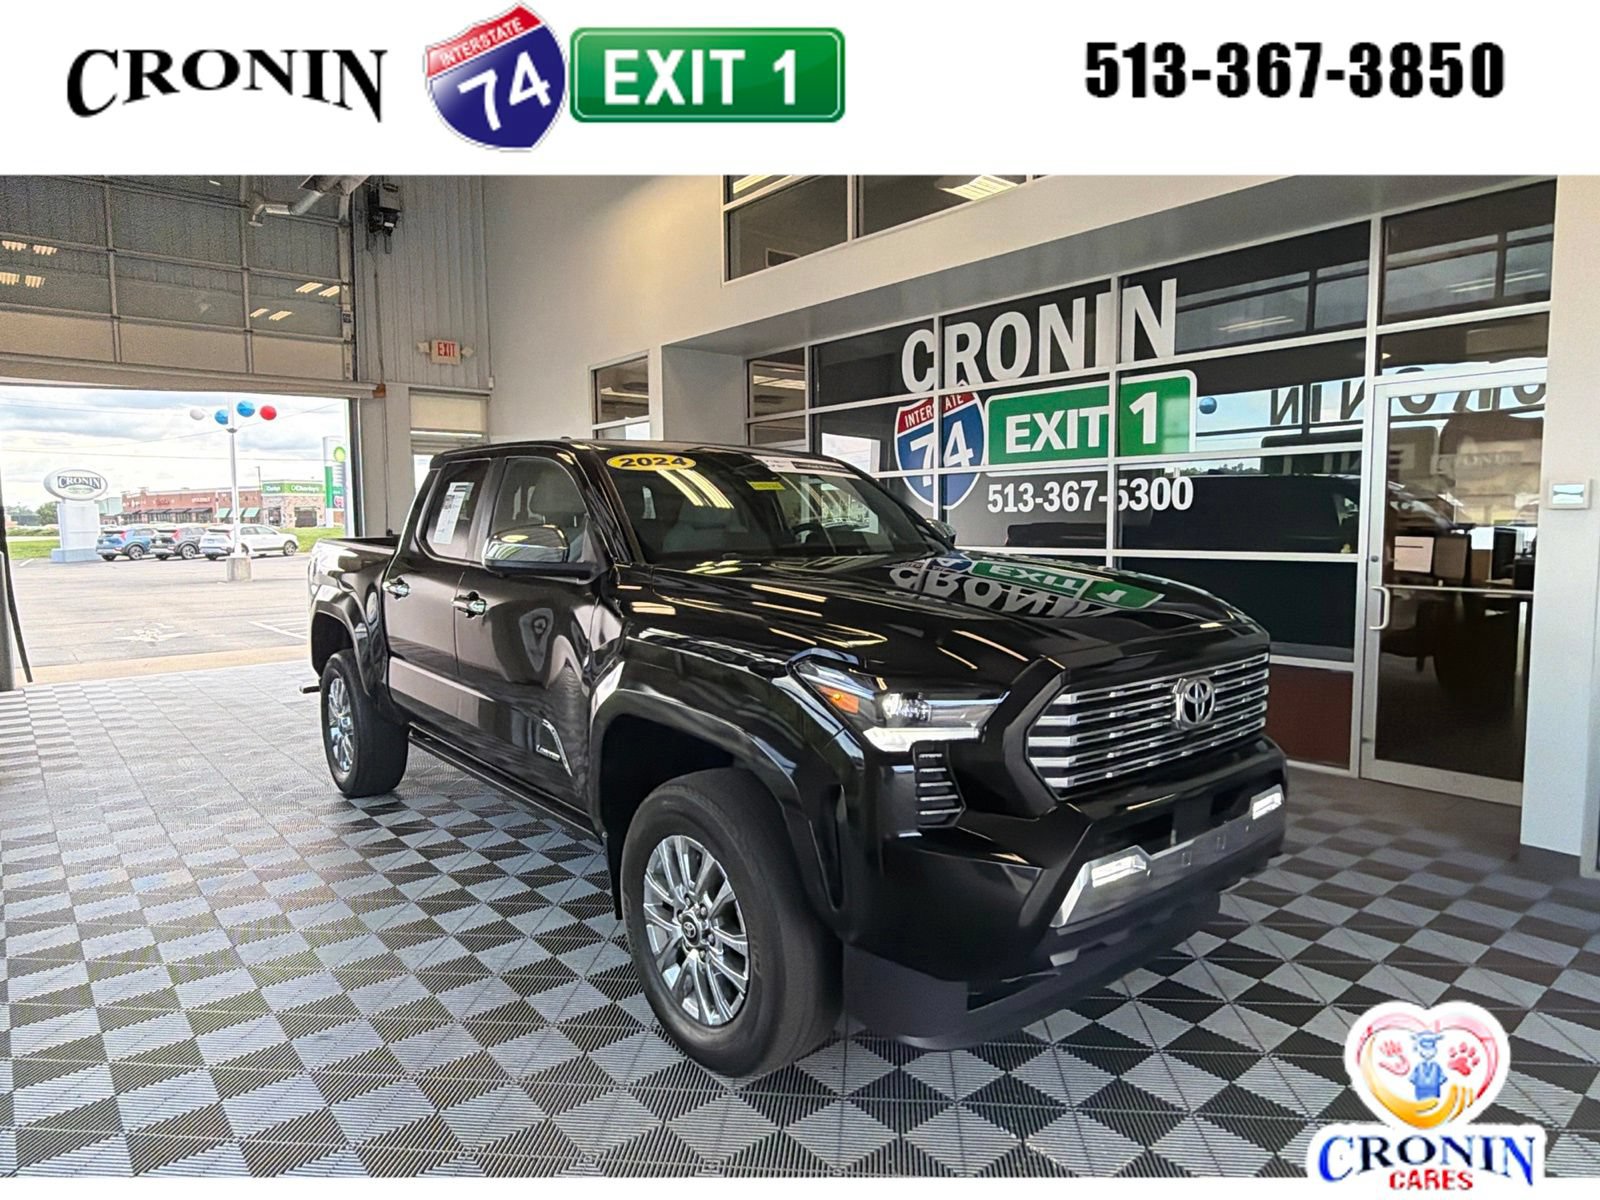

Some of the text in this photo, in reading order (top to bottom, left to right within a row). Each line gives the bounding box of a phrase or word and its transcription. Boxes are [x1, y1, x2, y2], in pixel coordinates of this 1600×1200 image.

[437, 341, 456, 358] EXIT
[901, 278, 1178, 393] CRONIN
[904, 394, 965, 429] INTERATE
[1005, 391, 1158, 455] EXIT 1
[619, 456, 687, 467] 2024
[909, 420, 974, 488] 74
[58, 475, 102, 489] CRONIN
[987, 476, 1195, 513] 513-367-5300
